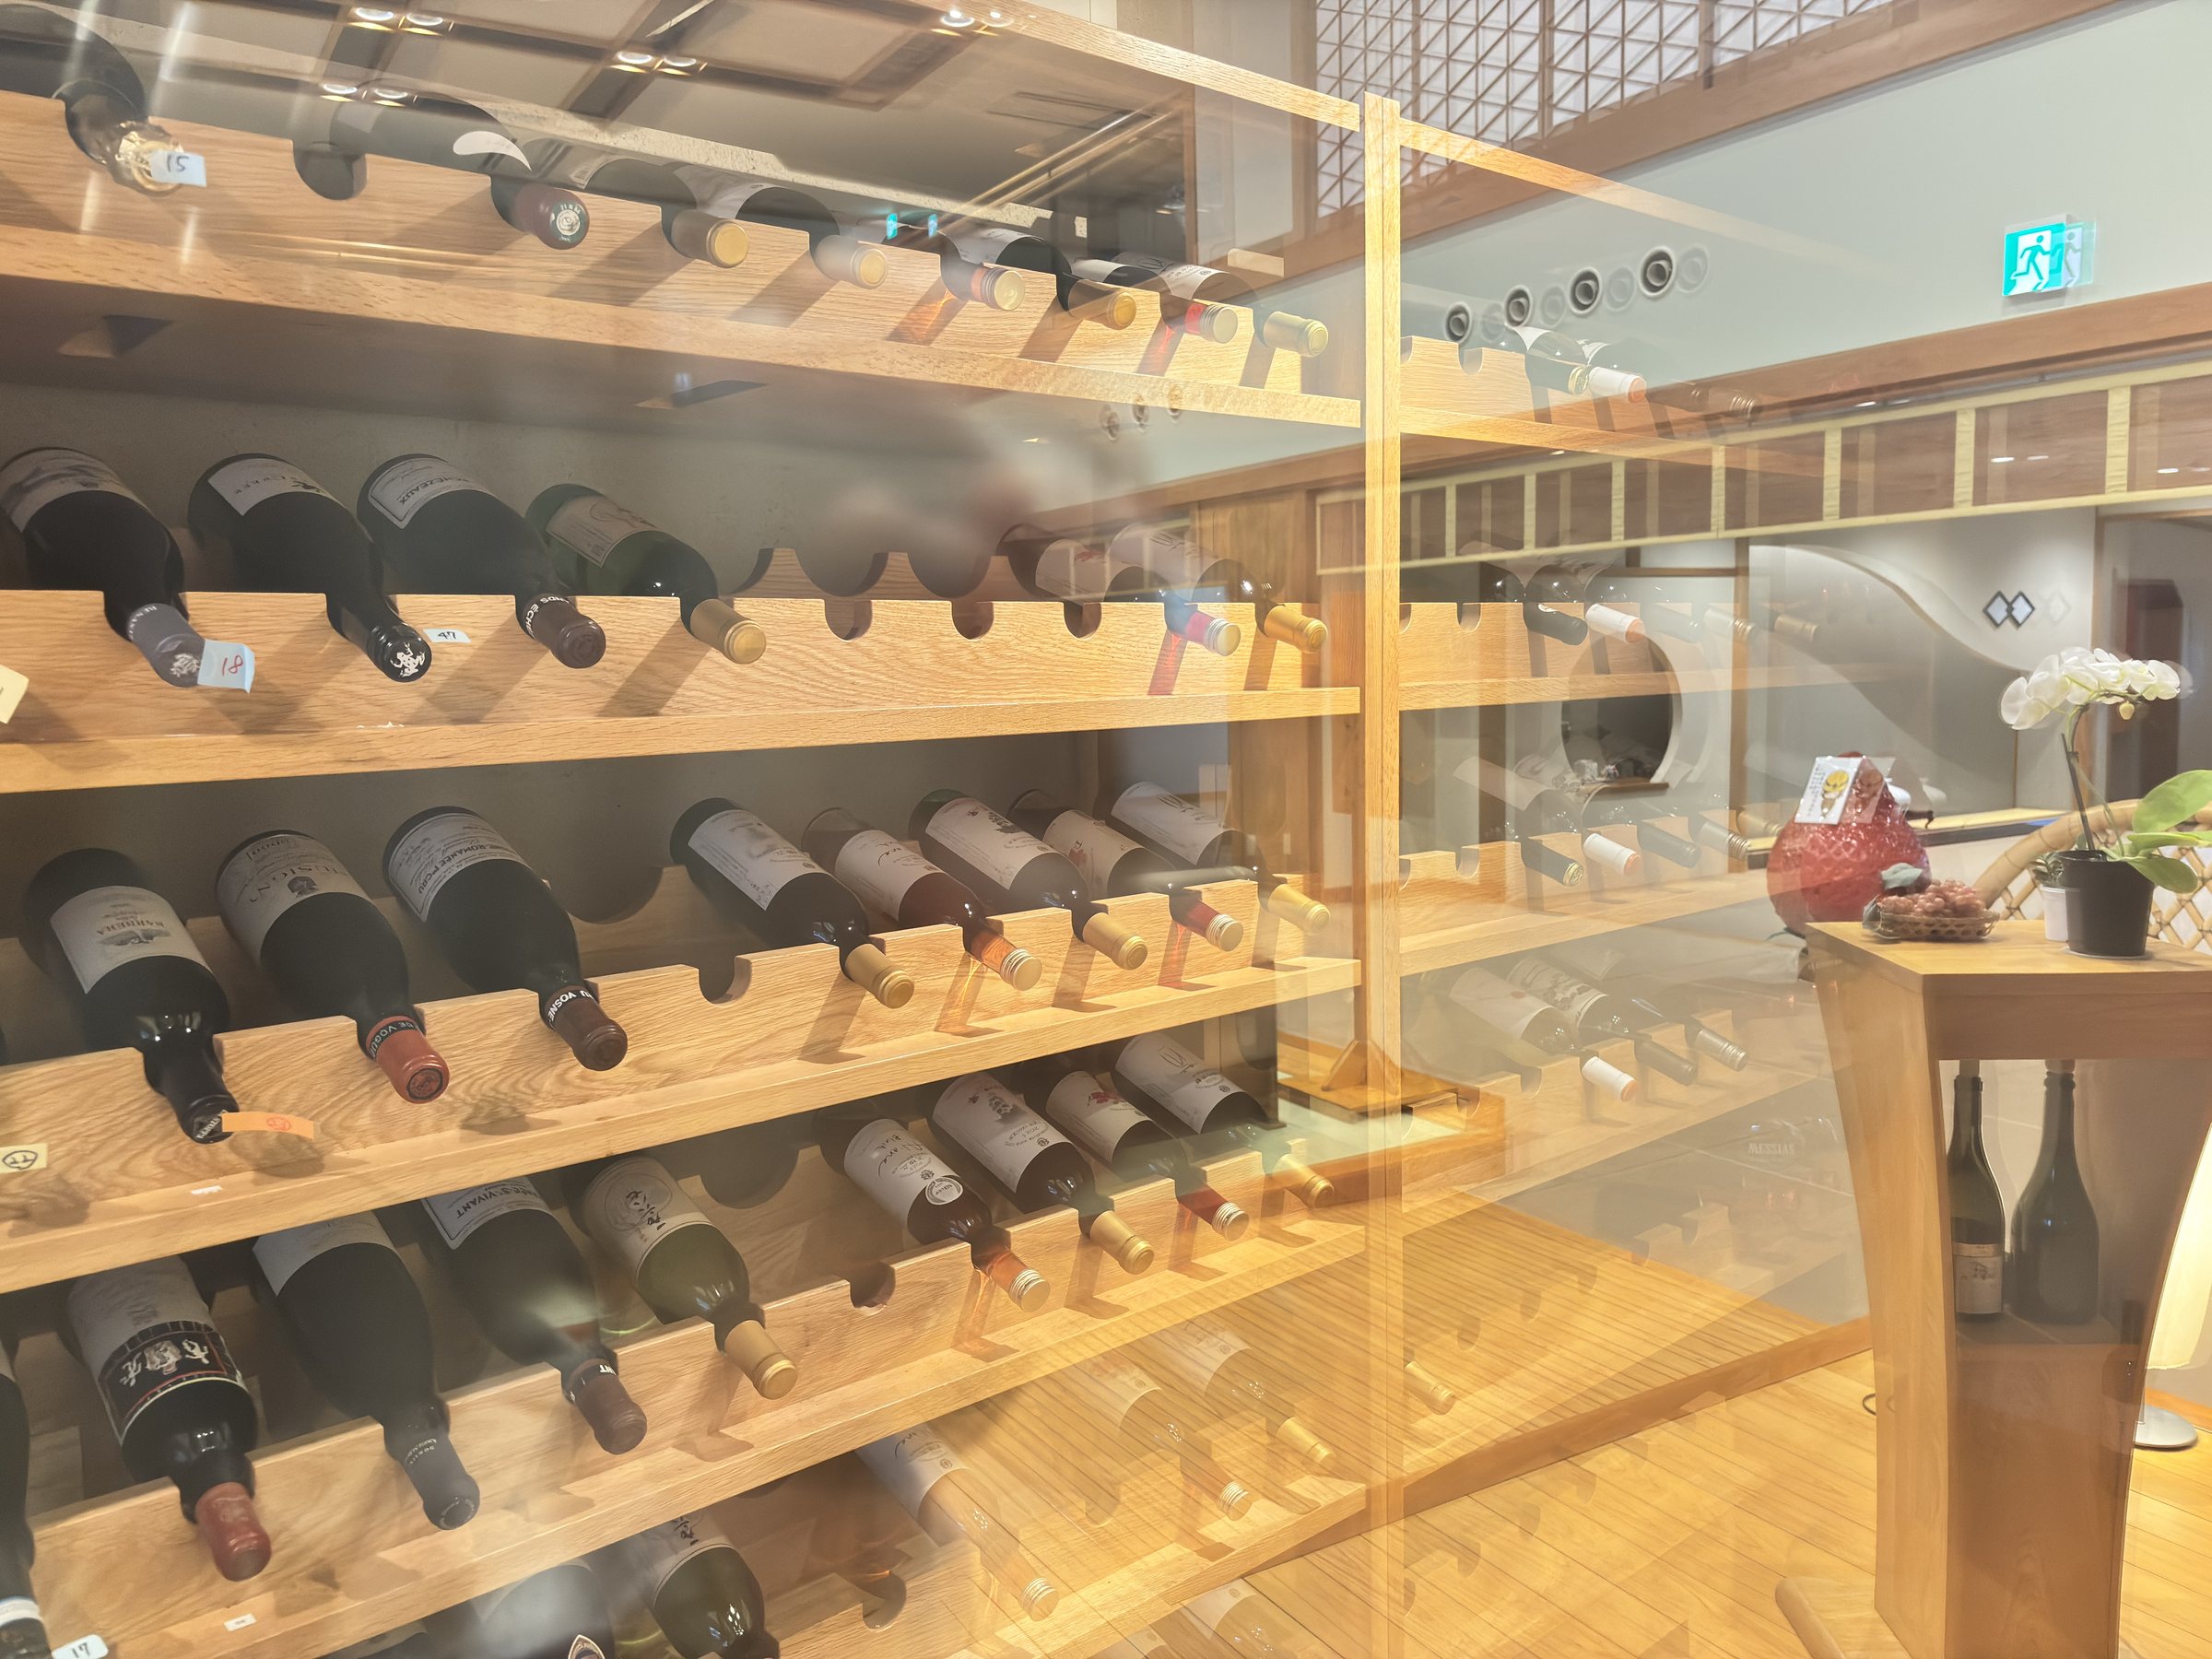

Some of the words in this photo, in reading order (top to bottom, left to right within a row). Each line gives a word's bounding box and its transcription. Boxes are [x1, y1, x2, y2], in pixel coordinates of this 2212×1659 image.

[167, 154, 189, 173] 15
[438, 630, 457, 640] 47
[222, 655, 243, 677] 18
[456, 1191, 499, 1218] VIVANT
